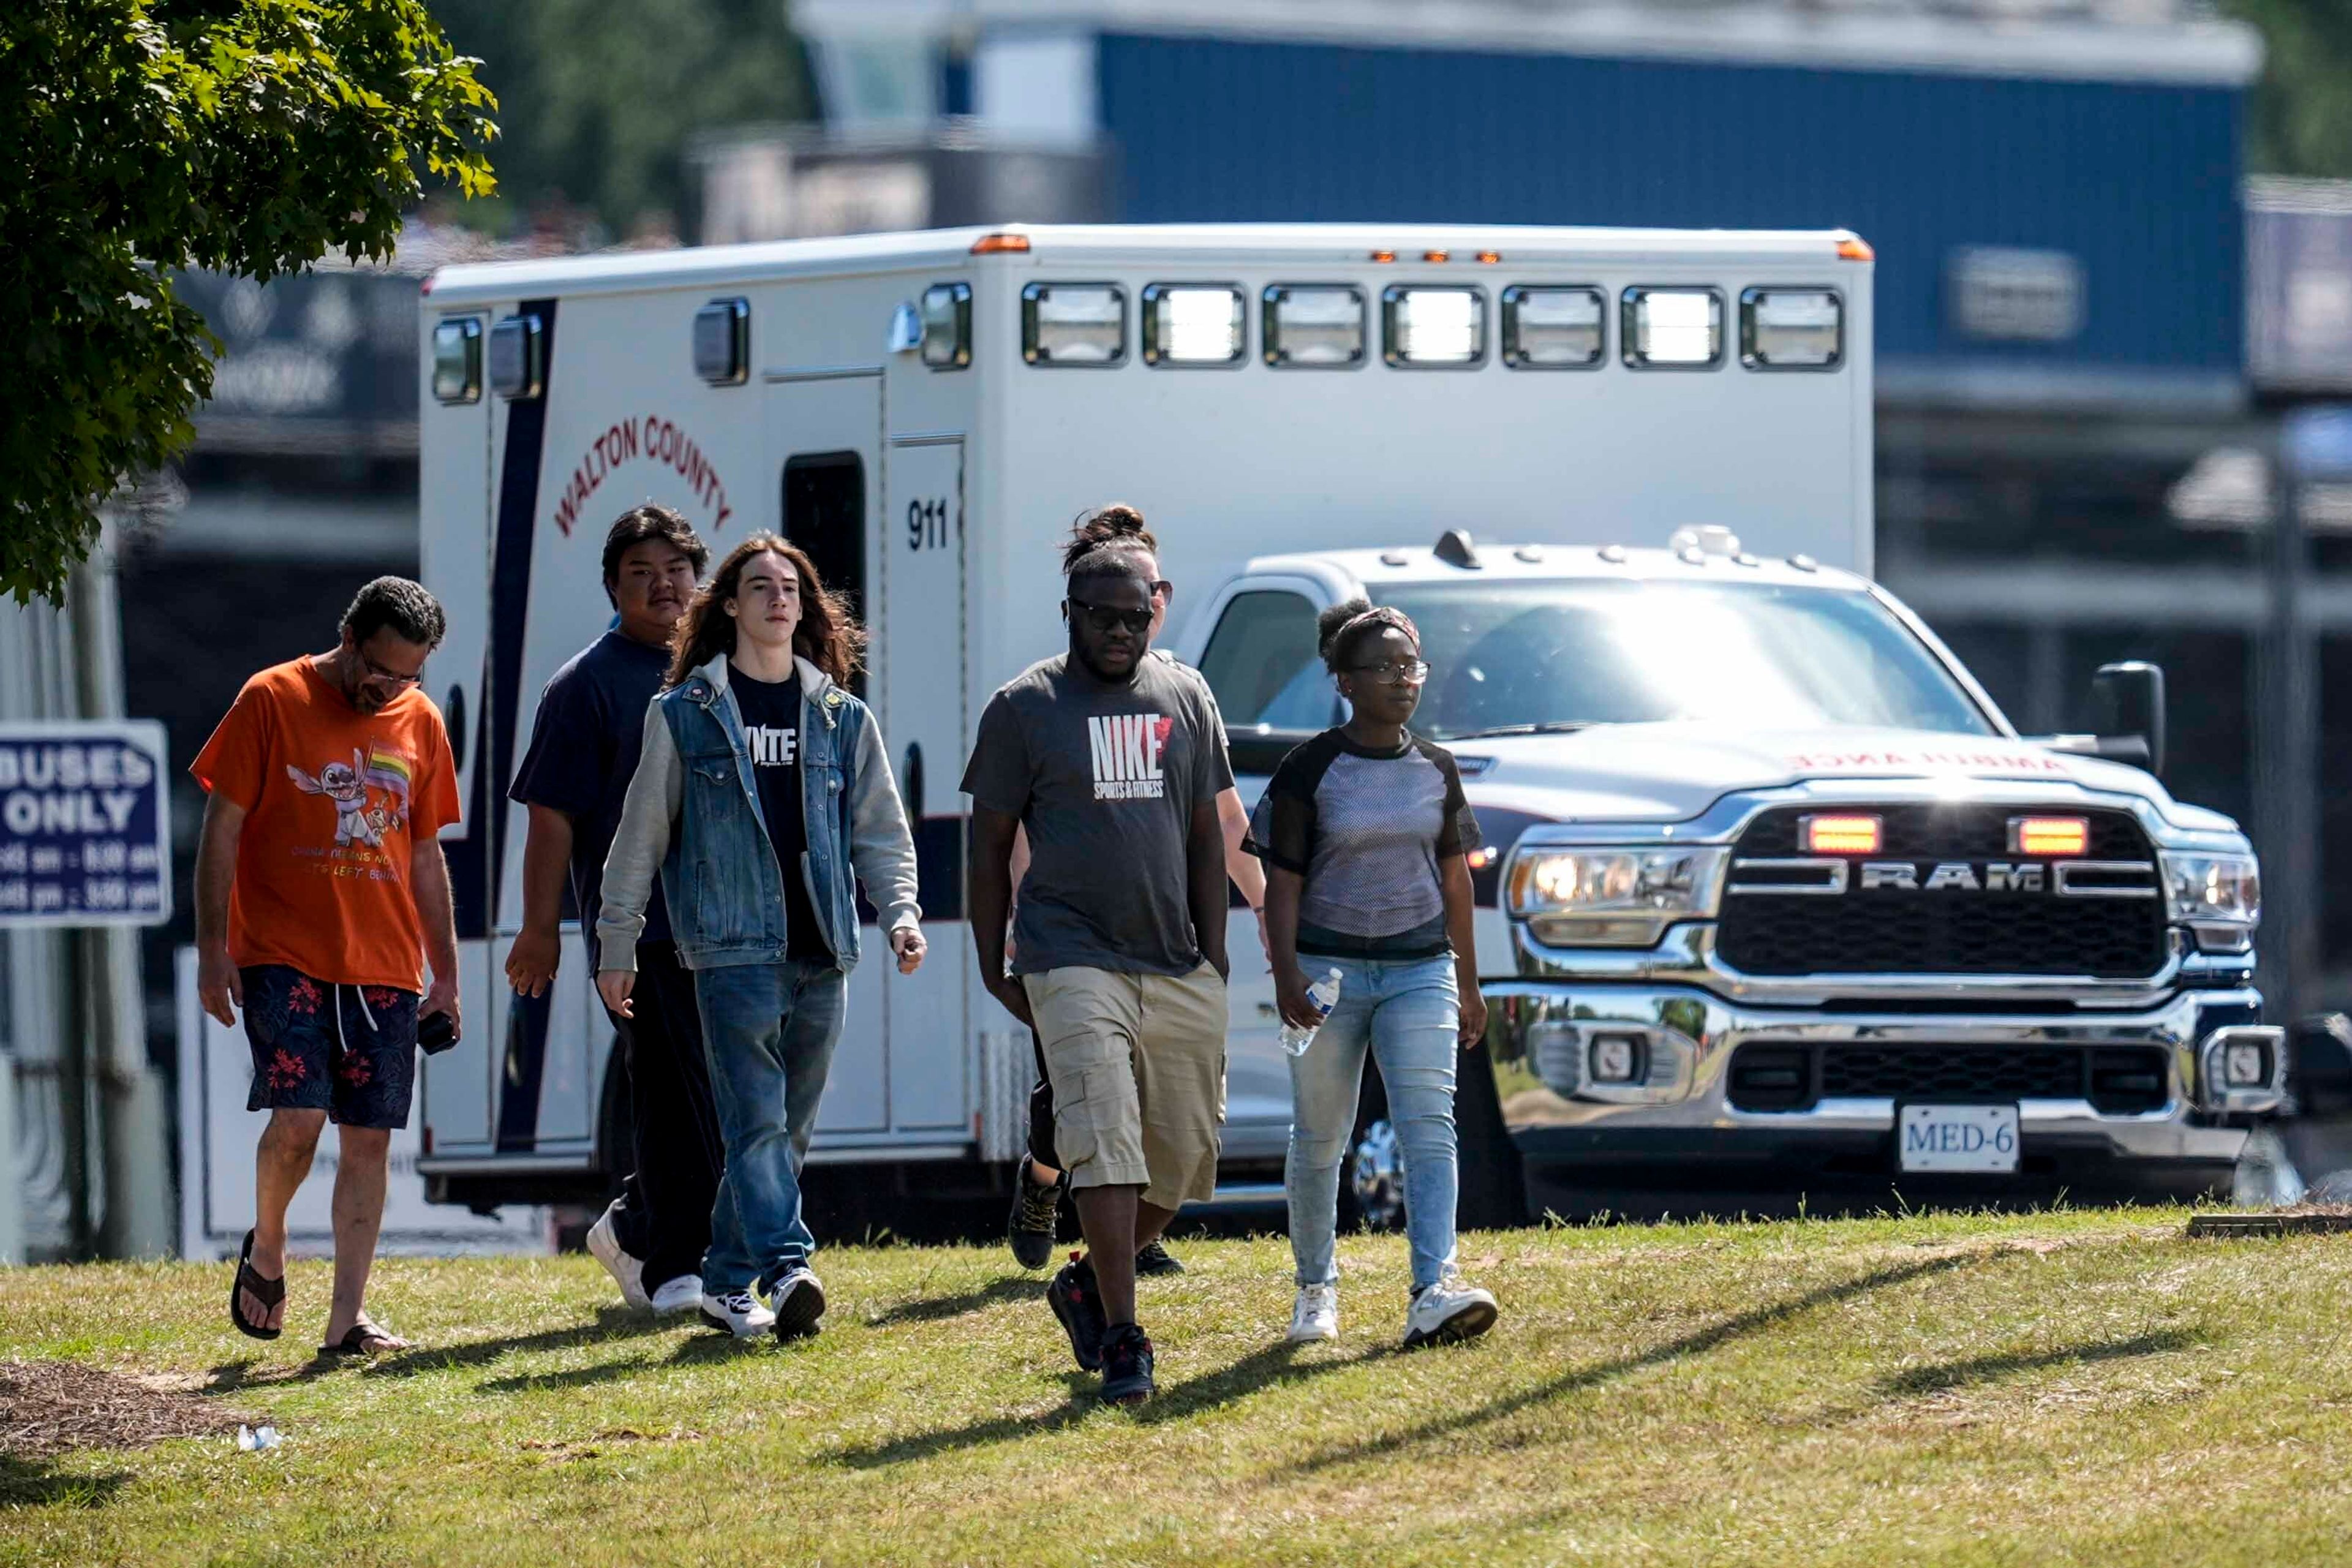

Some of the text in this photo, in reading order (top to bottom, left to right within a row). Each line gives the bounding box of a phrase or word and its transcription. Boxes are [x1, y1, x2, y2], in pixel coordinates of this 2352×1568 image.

[554, 415, 731, 537] WALTON COUNTY
[908, 499, 946, 551] 911
[1088, 714, 1163, 781] NIKE
[1094, 780, 1163, 799] SPORTS & FITNESS
[4, 790, 137, 835] ONLY
[1861, 862, 2043, 891] RAM
[1906, 1122, 2013, 1153] MED-6
